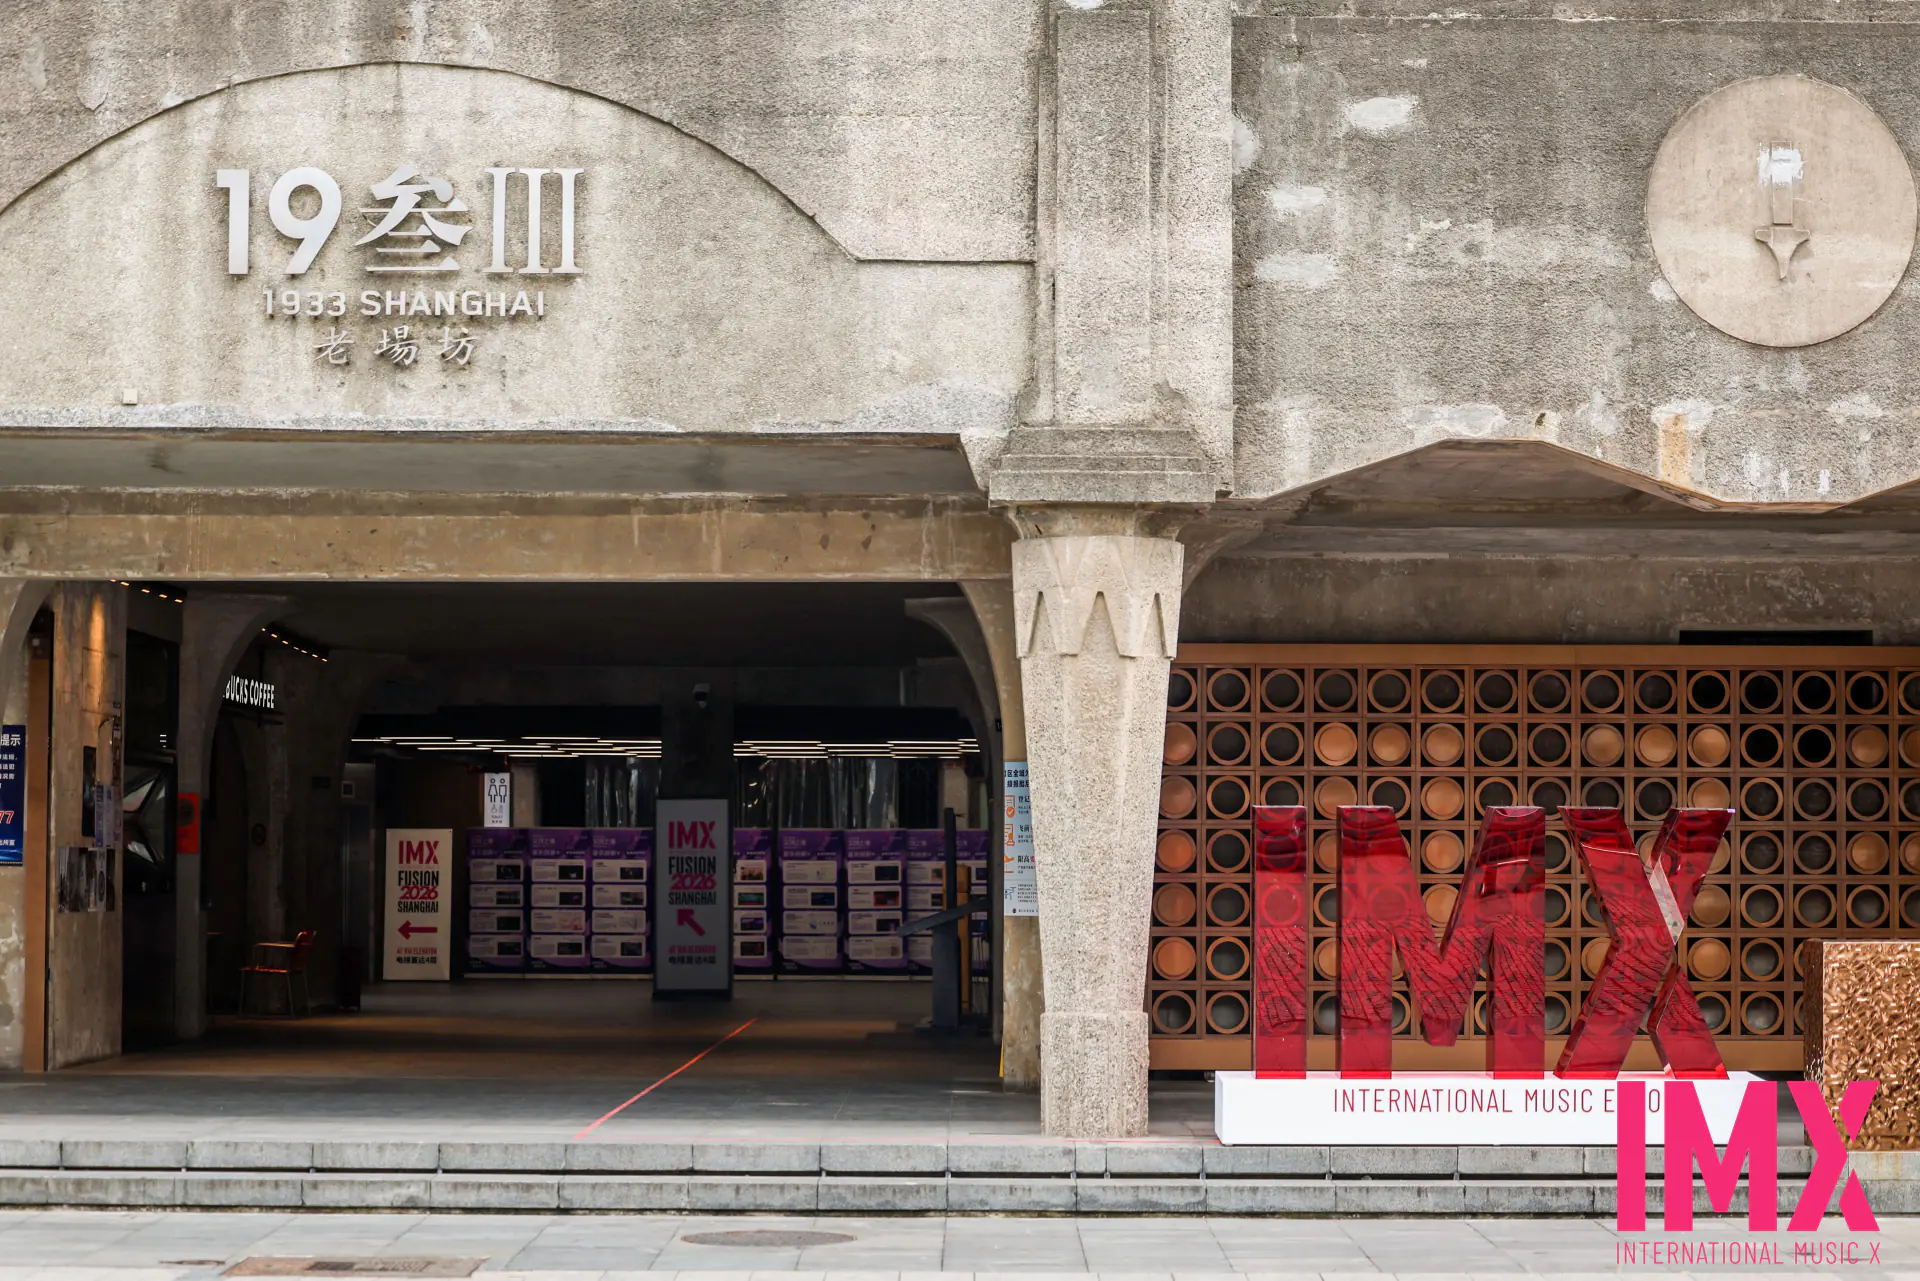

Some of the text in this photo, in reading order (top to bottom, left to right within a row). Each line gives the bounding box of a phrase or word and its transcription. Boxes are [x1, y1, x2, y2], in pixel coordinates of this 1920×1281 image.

[262, 289, 545, 317] 1933 SHANGHAI
[249, 679, 274, 709] COFFEE
[668, 821, 716, 849] IMX
[398, 840, 440, 865] IMX
[668, 856, 716, 875] FUSION
[398, 870, 439, 887] FUSION
[670, 874, 716, 890] 2026
[399, 885, 439, 900] 2026
[668, 891, 716, 905] SHANGHAI
[397, 901, 439, 913] SHANGHAI
[1252, 805, 1735, 1080] IMX
[1334, 1088, 1661, 1113] INTERNATIONAL MUSIC EO
